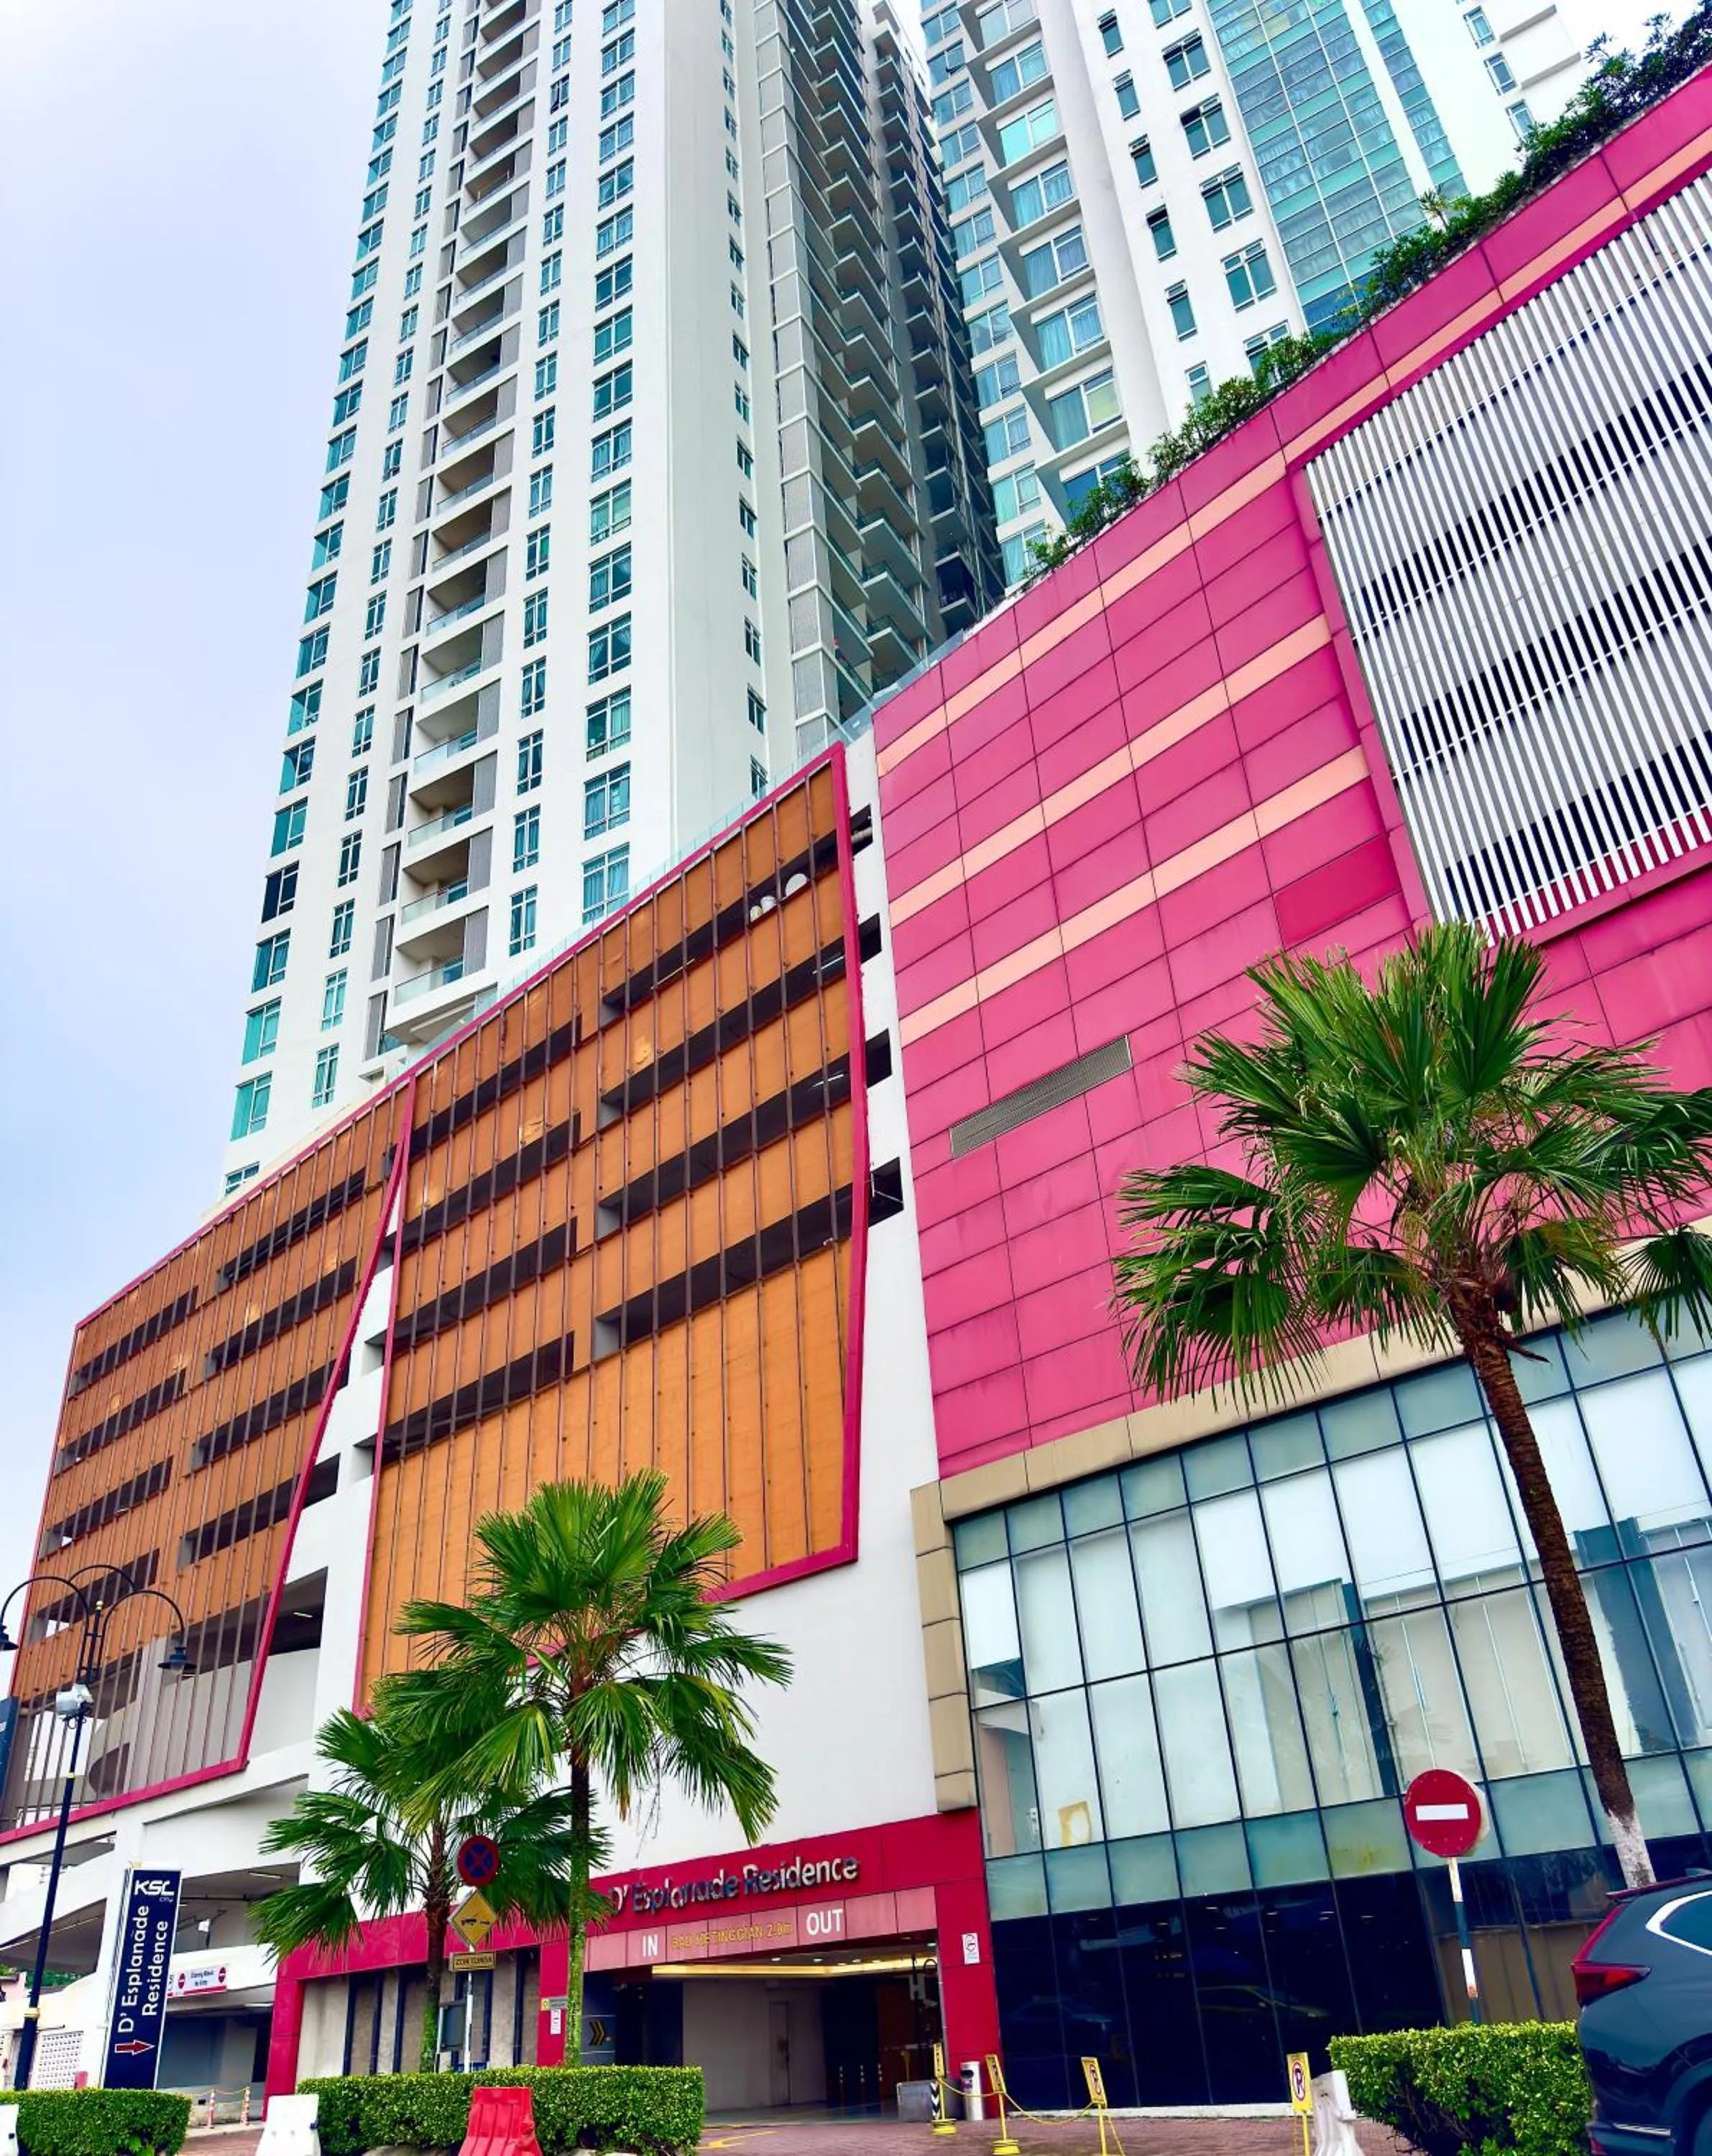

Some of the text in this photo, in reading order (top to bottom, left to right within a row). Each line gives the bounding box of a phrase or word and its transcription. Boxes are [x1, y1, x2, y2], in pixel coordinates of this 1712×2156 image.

[134, 1879, 175, 1897] KSL
[632, 1868, 740, 1916] Esplanade
[742, 1856, 858, 1895] Residence
[806, 1908, 843, 1935] OUT
[643, 1933, 658, 1958] IN
[117, 1905, 149, 2033] D' Esplanade
[142, 1920, 168, 2017] Residence
